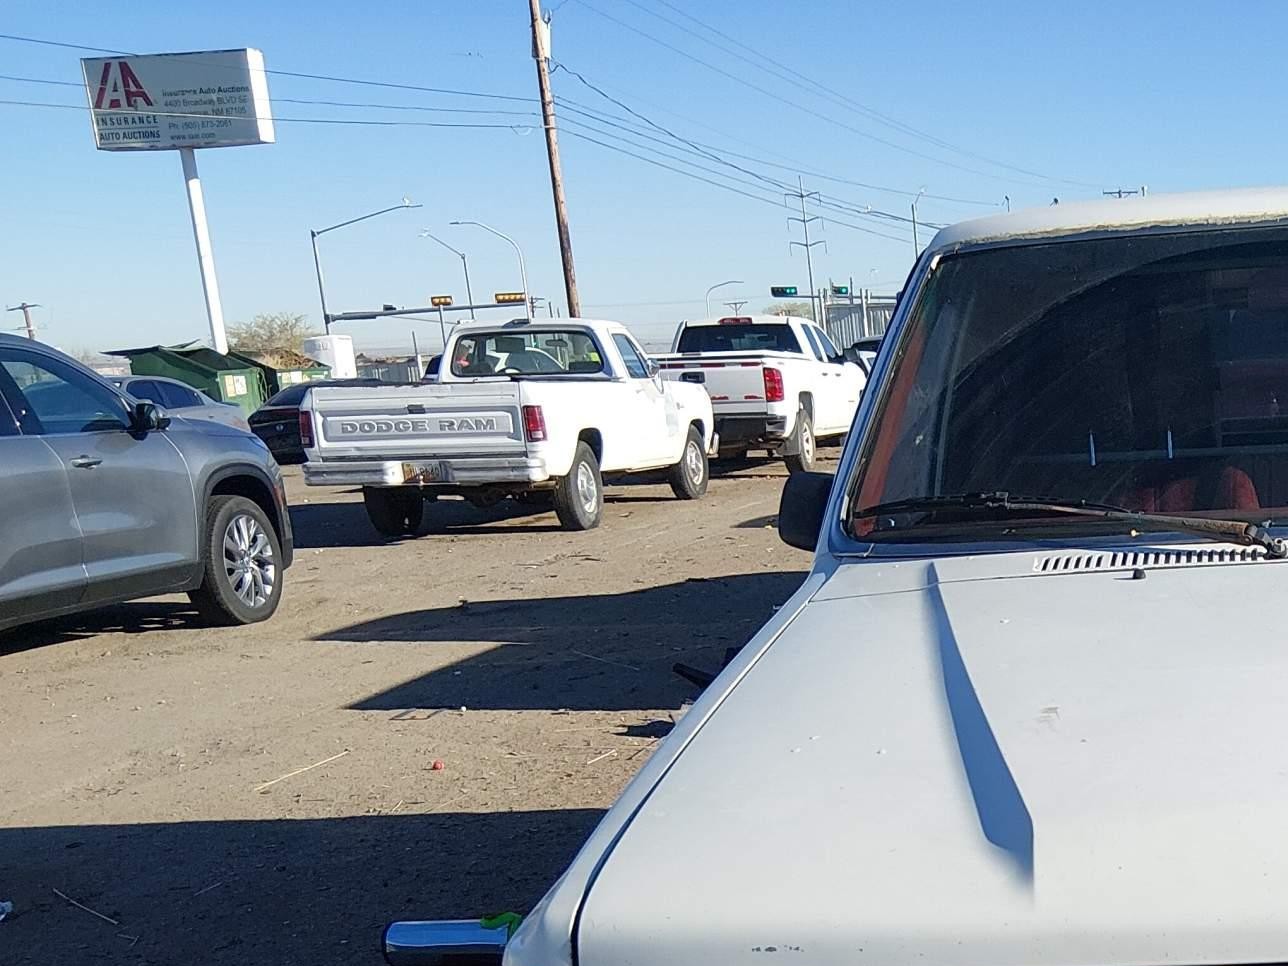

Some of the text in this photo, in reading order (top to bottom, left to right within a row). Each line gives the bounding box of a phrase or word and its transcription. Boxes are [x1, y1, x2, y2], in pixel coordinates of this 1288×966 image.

[199, 87, 216, 95] Auto
[217, 85, 250, 94] Auctions
[96, 114, 159, 127] INSURANCE
[100, 129, 161, 142] AUTO AUCTIONS
[341, 416, 497, 435] DODGE RAM
